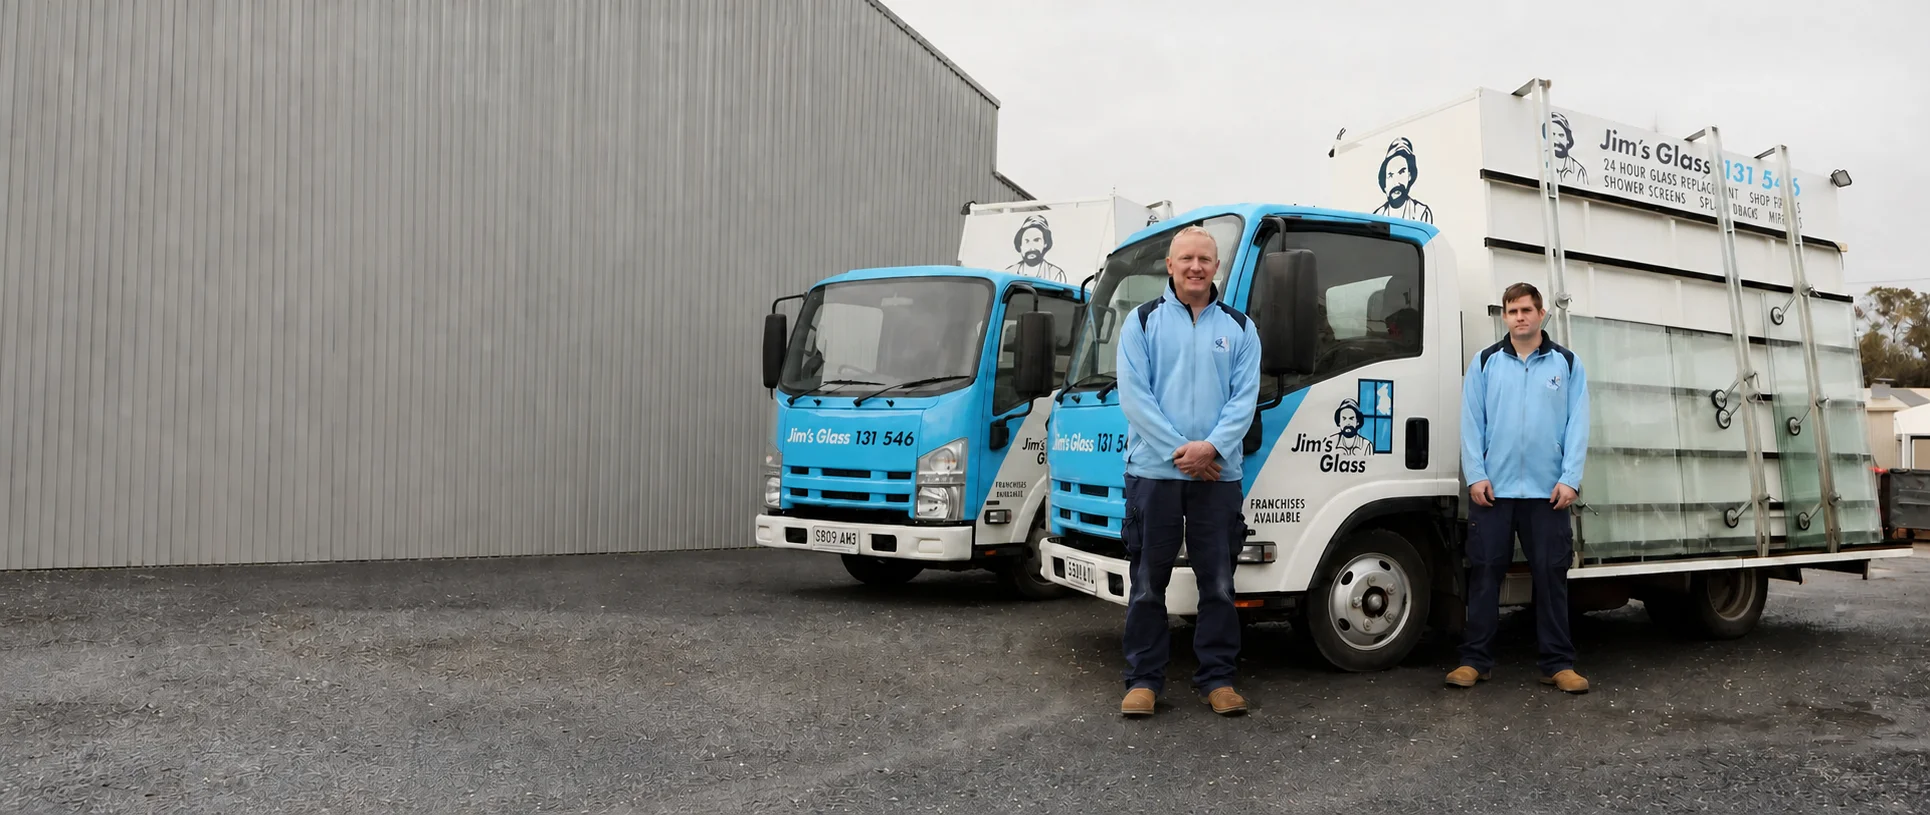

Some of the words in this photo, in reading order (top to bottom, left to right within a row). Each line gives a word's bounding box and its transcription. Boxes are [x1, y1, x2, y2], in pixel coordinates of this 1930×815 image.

[1599, 128, 1650, 160] Jim's
[1656, 142, 1711, 175] Glass
[1724, 159, 1753, 185] 131
[1603, 158, 1616, 172] 24
[1620, 161, 1646, 179] HOUR
[1649, 168, 1677, 187] GLASS
[1680, 175, 1739, 200] REPLACNT
[1749, 191, 1770, 207] SHOP
[1603, 174, 1645, 196] SHOWER
[1648, 184, 1687, 205] SCREENS
[787, 427, 813, 443] Jim's
[816, 428, 851, 445] Glass
[856, 430, 877, 446] 131
[882, 431, 914, 447] 546
[1021, 437, 1046, 452] Jim's
[1052, 432, 1070, 452] Jim's
[1070, 432, 1095, 453] Glass
[1097, 432, 1113, 453] 131
[1290, 433, 1333, 453] Jim's
[1320, 454, 1366, 474] Glass
[1250, 498, 1306, 510] FRANCHISES
[1253, 511, 1301, 524] AVAILABLE
